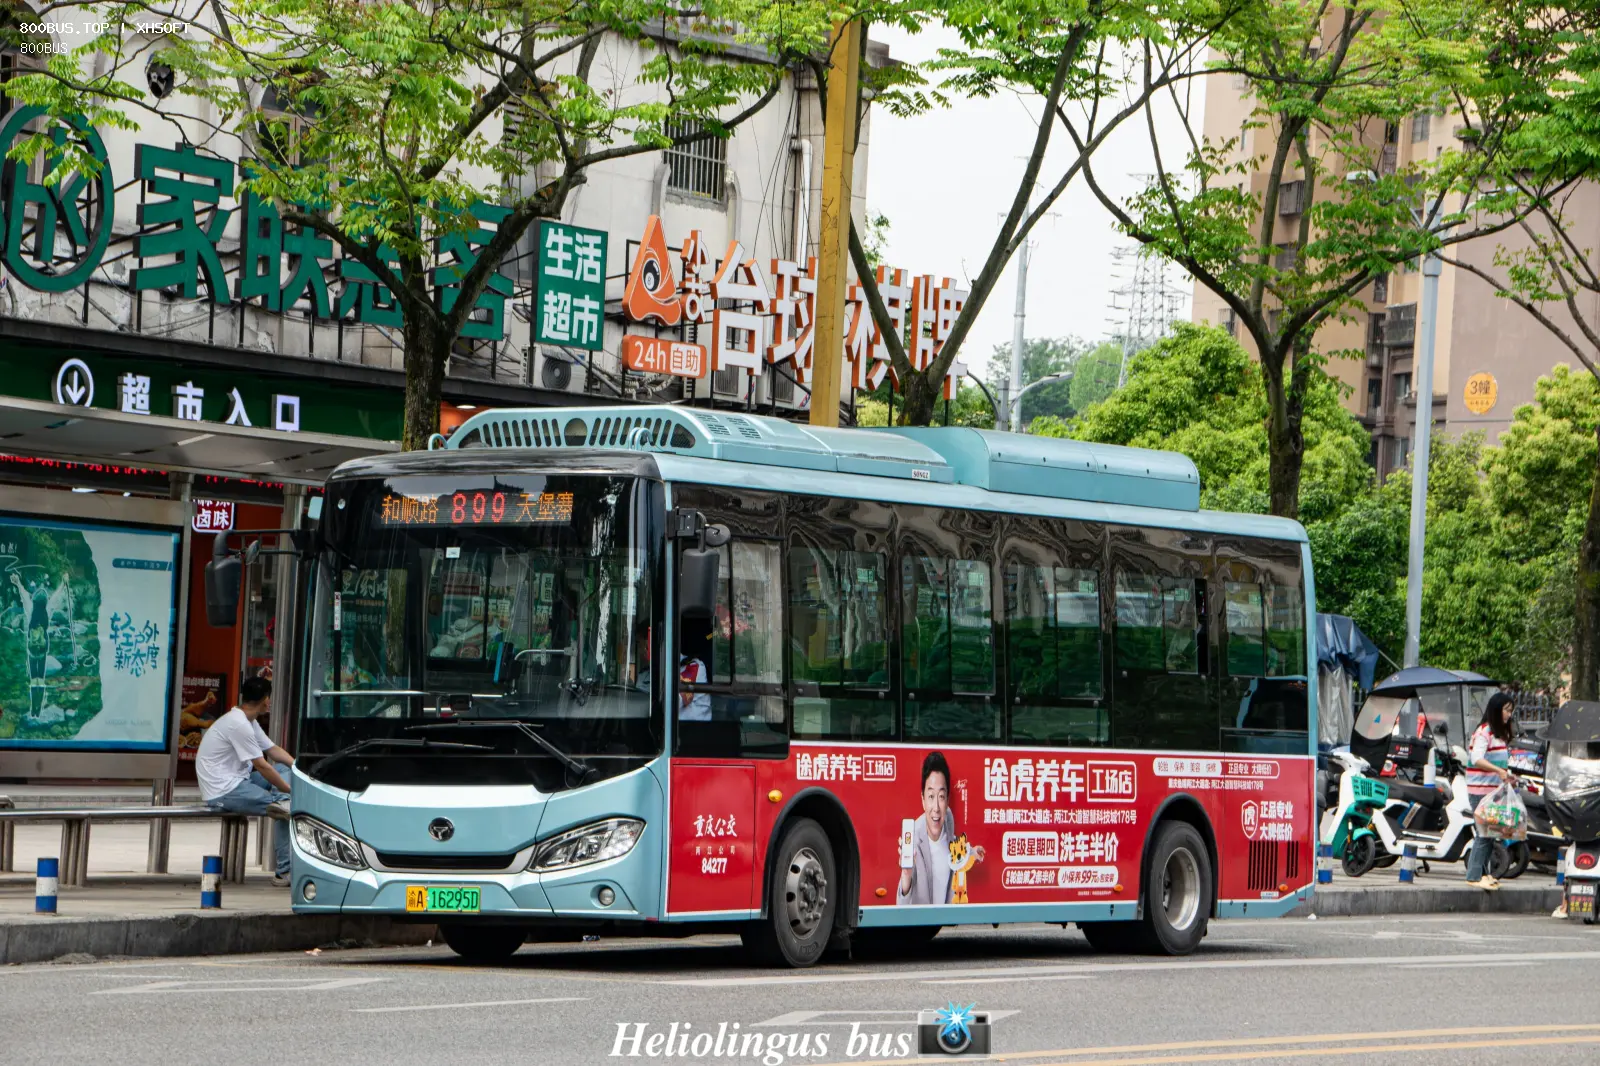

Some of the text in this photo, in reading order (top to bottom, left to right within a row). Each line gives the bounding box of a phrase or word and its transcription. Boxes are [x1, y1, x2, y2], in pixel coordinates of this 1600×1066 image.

[544, 227, 602, 284] 生活
[541, 289, 600, 344] 超市
[634, 340, 699, 372] 24h 自助
[119, 371, 301, 433] 超市入口
[196, 507, 231, 530] 卤味
[380, 494, 440, 525] 和顺路
[451, 492, 506, 524] 899
[113, 642, 160, 678] 新态度
[796, 752, 894, 781] 途虎养车 工场店
[984, 757, 1133, 803] 途虎养车 工场店
[1259, 800, 1294, 819] 正品专业
[693, 814, 738, 838] 重庆公交
[1259, 821, 1293, 841] 大牌低价
[1006, 832, 1119, 863] 超级星期四 洗车半价
[701, 857, 728, 874] 84277
